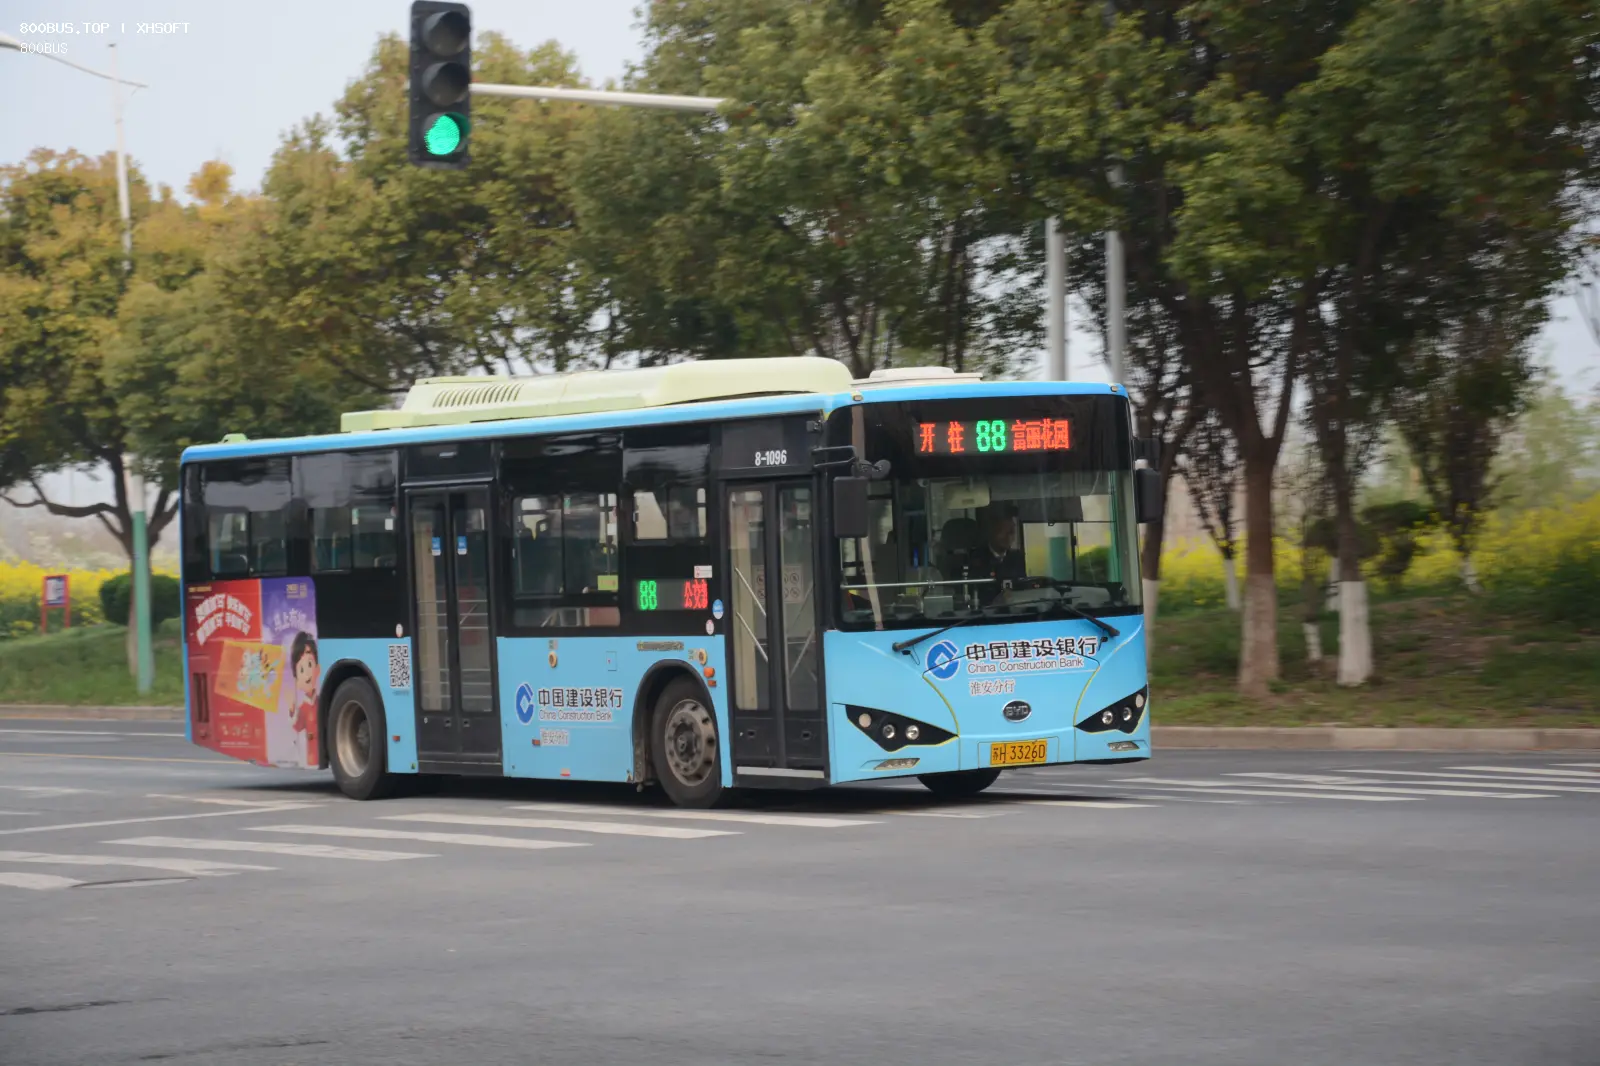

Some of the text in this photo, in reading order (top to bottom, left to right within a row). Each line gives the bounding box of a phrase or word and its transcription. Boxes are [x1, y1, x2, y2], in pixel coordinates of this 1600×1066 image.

[976, 419, 1006, 452] 88
[1011, 418, 1070, 451] 富丽花园
[754, 449, 788, 466] 8-1096
[639, 580, 658, 610] 88
[965, 636, 1099, 661] 中国建设银行
[967, 656, 1085, 674] China Construction Bank
[970, 680, 1015, 695] 淮安分行
[538, 688, 623, 708] 中国建设银行
[539, 709, 613, 721] China Construction Bank
[1005, 704, 1029, 717] BYD
